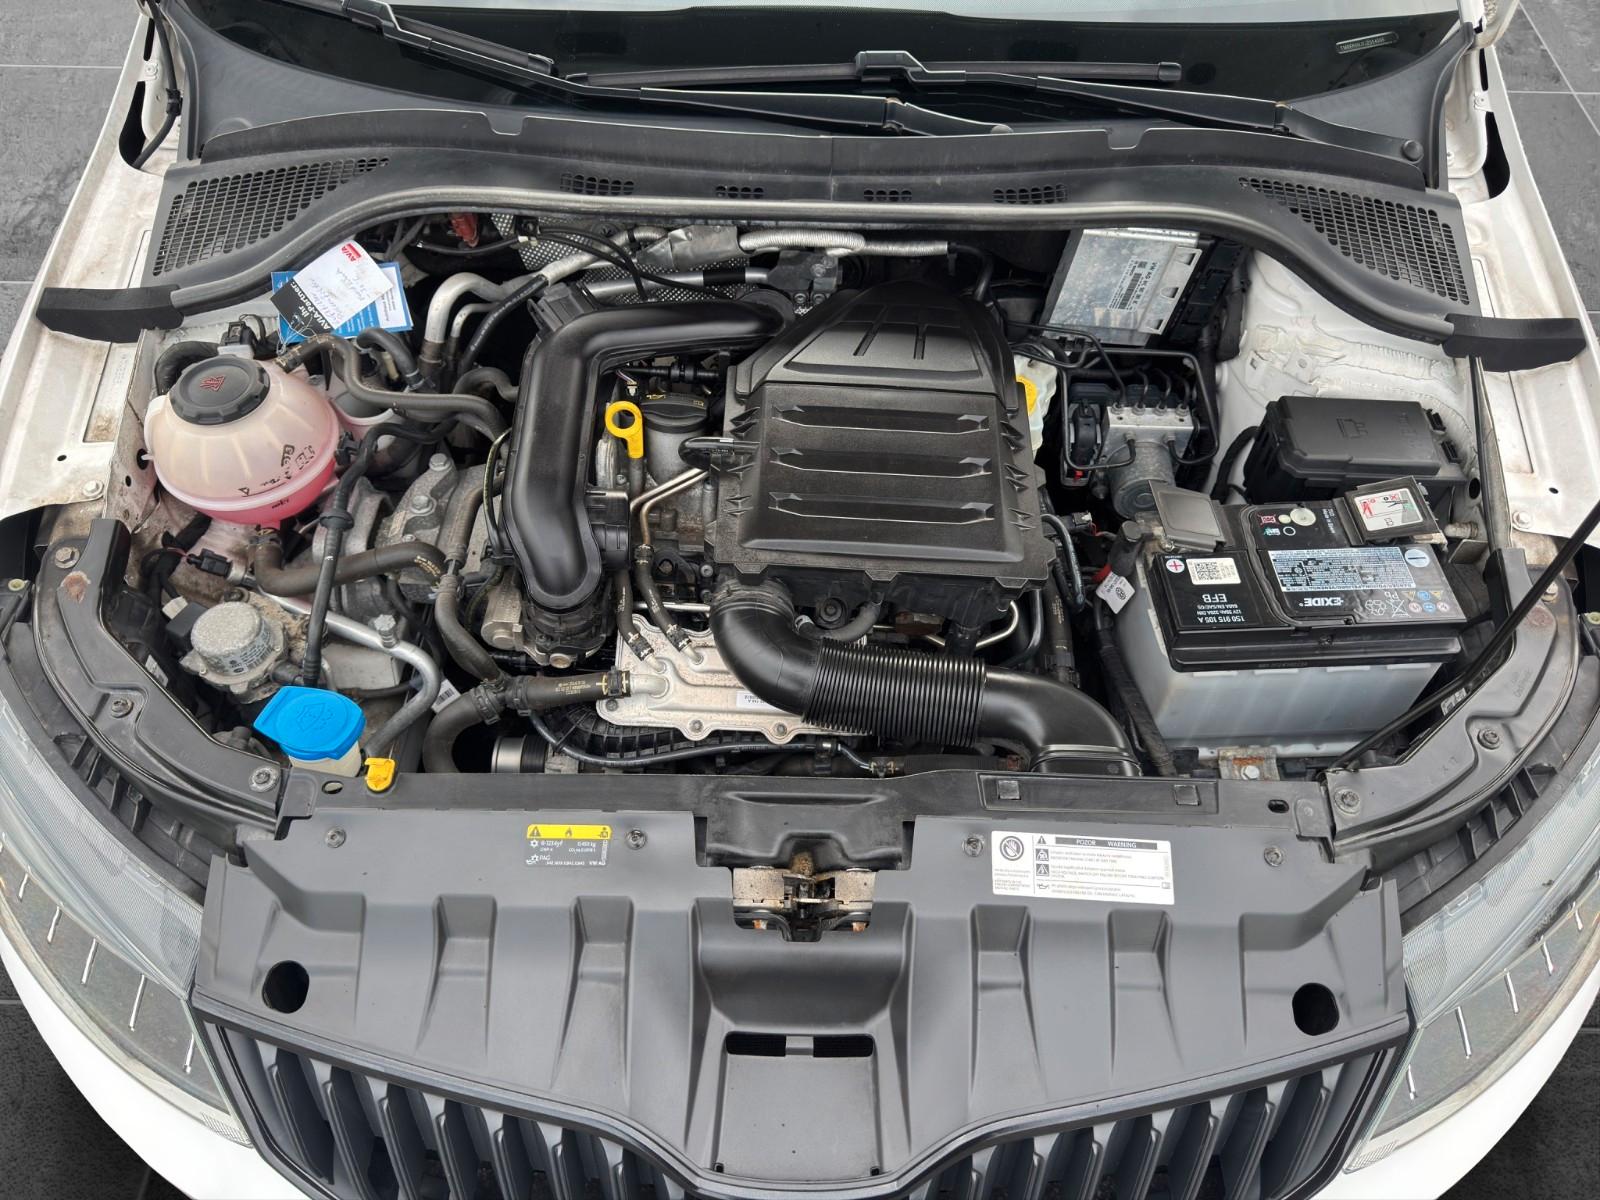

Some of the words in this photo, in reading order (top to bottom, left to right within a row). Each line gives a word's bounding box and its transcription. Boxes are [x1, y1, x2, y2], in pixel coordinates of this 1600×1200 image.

[340, 245, 357, 262] AVIA
[290, 281, 331, 330] AVIA-Partner:
[298, 305, 310, 318] Ihr
[1202, 593, 1228, 603] EFB
[1303, 596, 1344, 607] EXIDE
[1077, 838, 1097, 846] POZOR
[1107, 840, 1137, 849] WARNING
